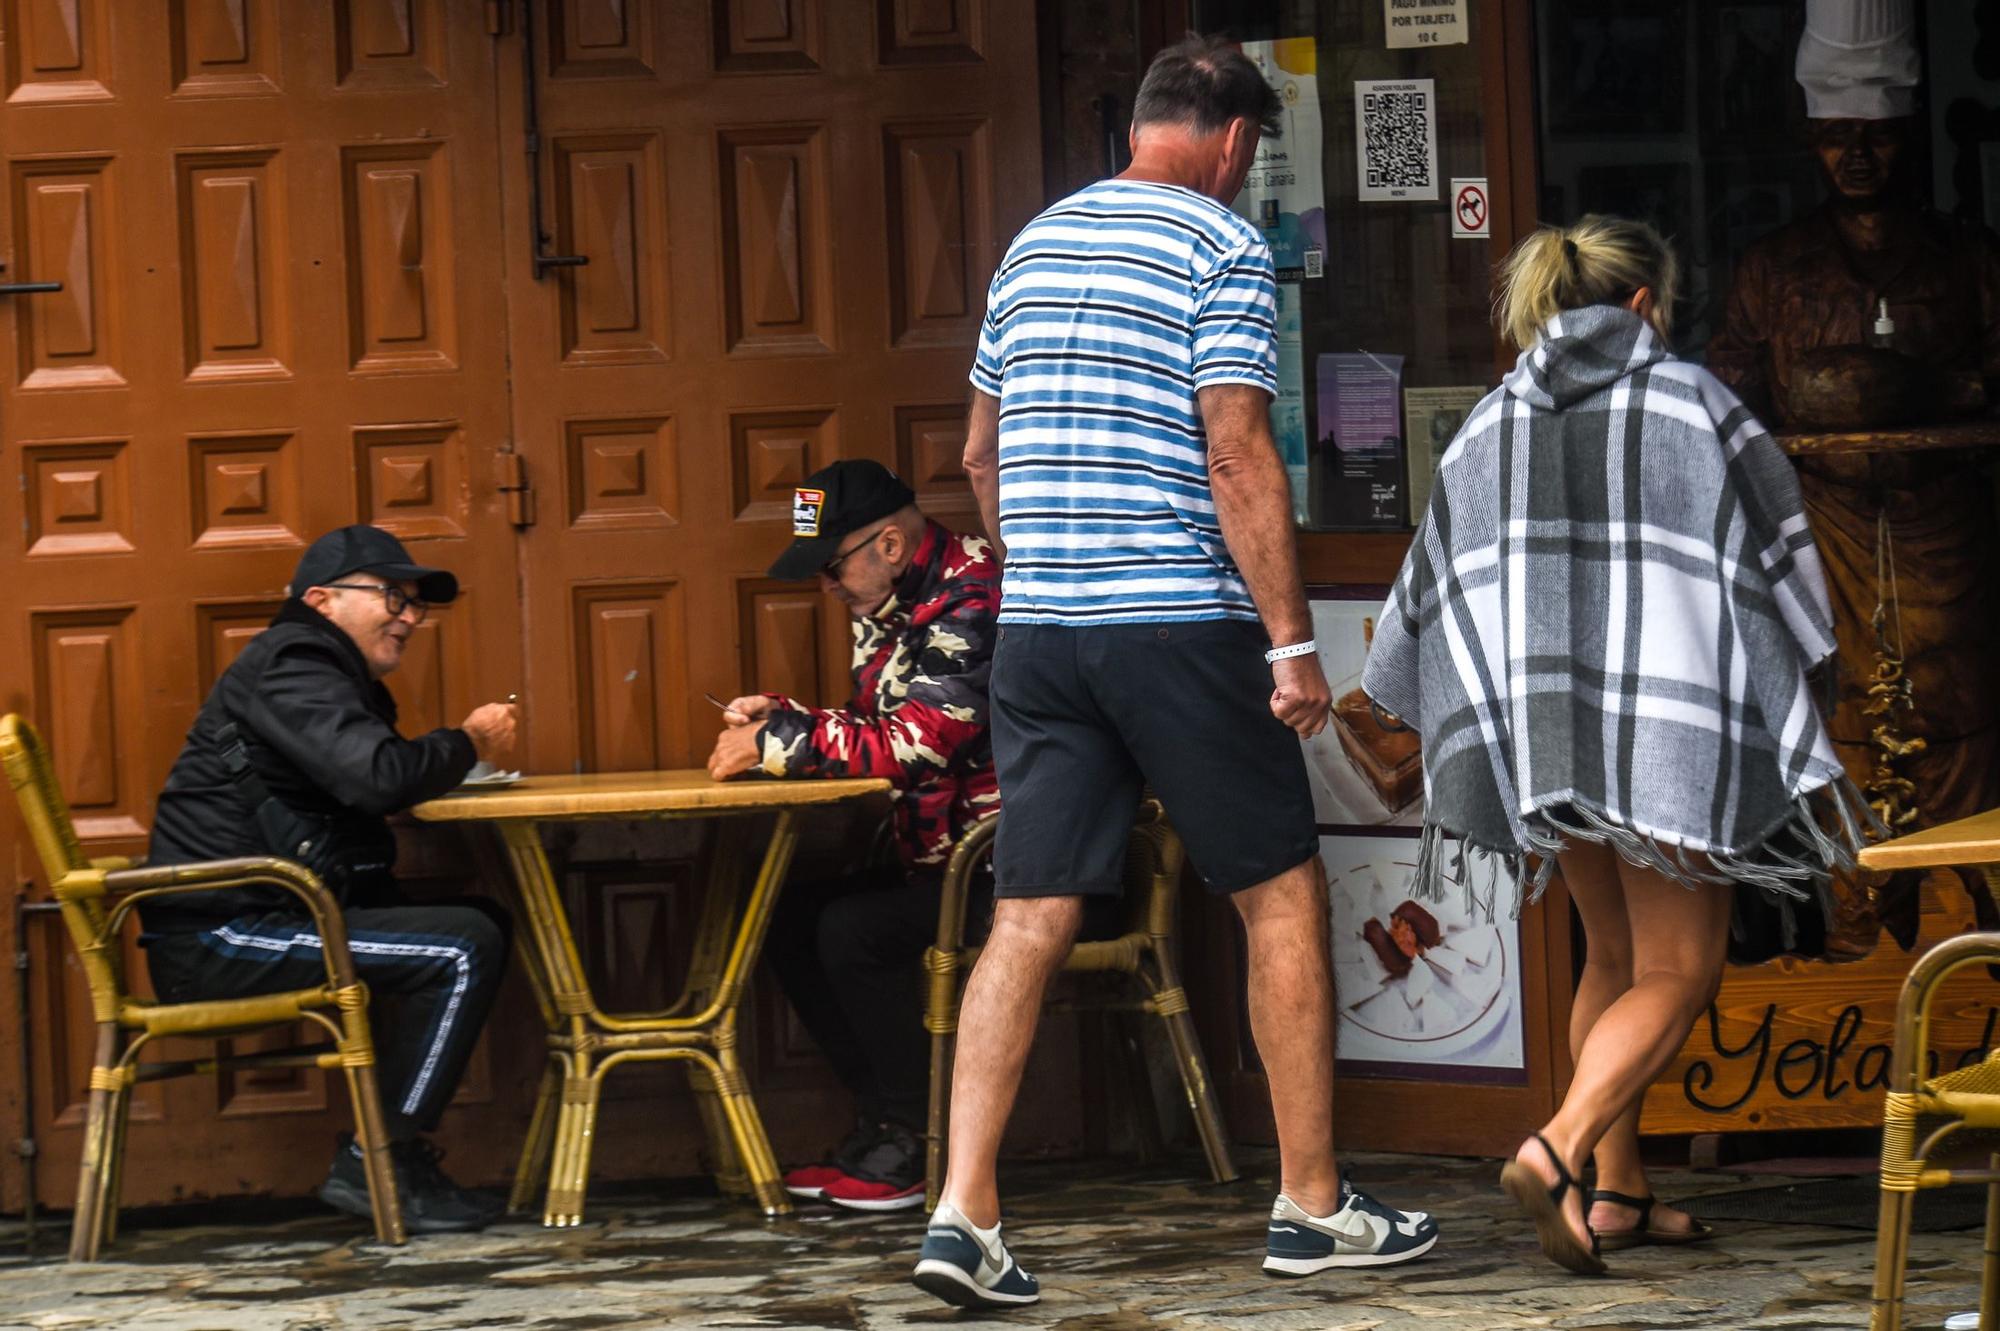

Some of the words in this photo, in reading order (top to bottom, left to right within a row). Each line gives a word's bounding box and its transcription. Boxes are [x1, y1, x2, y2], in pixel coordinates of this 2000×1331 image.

[1392, 16, 1412, 26] POR
[1414, 14, 1457, 25] TARJETA
[1417, 33, 1430, 42] 10
[1431, 32, 1438, 42] €
[1684, 1001, 2000, 1115] Yolad
